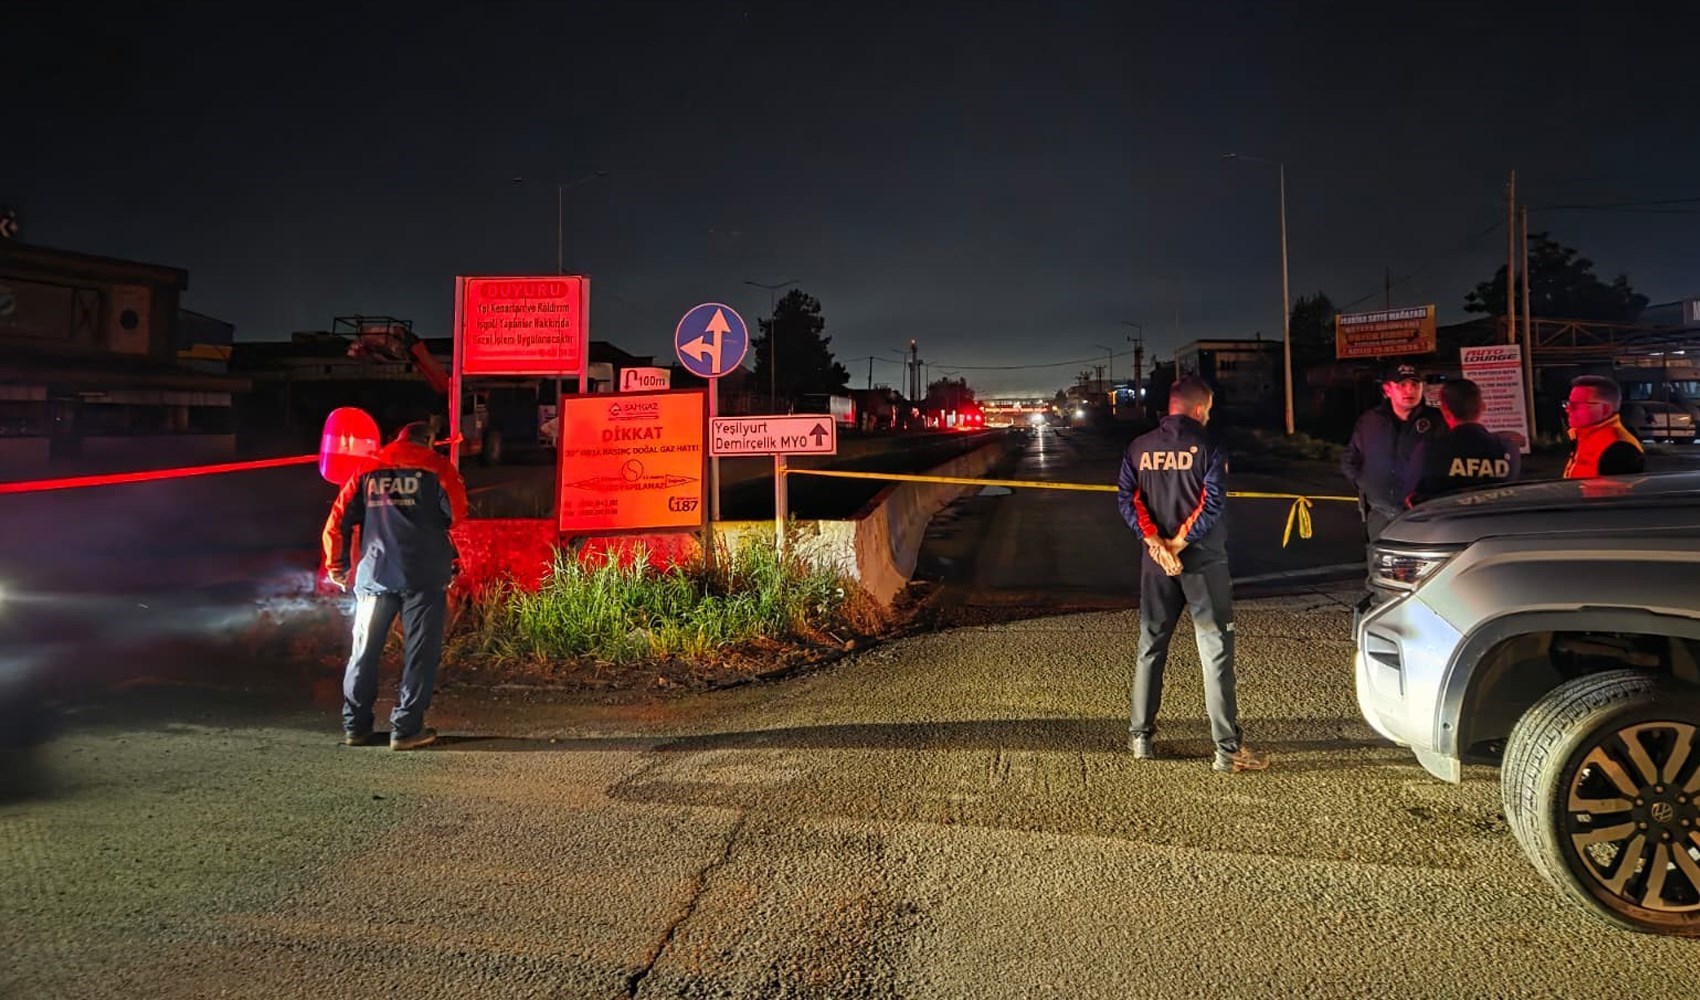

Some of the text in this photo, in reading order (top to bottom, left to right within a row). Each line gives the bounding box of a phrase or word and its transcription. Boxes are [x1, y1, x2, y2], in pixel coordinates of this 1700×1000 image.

[487, 284, 561, 297] DUYURU
[639, 375, 666, 387] 100m
[601, 426, 663, 443] DİKKAT
[715, 422, 768, 437] Yeşilyurt
[660, 445, 676, 453] GAZ
[715, 435, 808, 450] Demirçelik MYO
[1139, 452, 1194, 471] AFAD
[1449, 459, 1509, 478] AFAD
[367, 477, 419, 497] AFAD
[674, 500, 699, 512] 187
